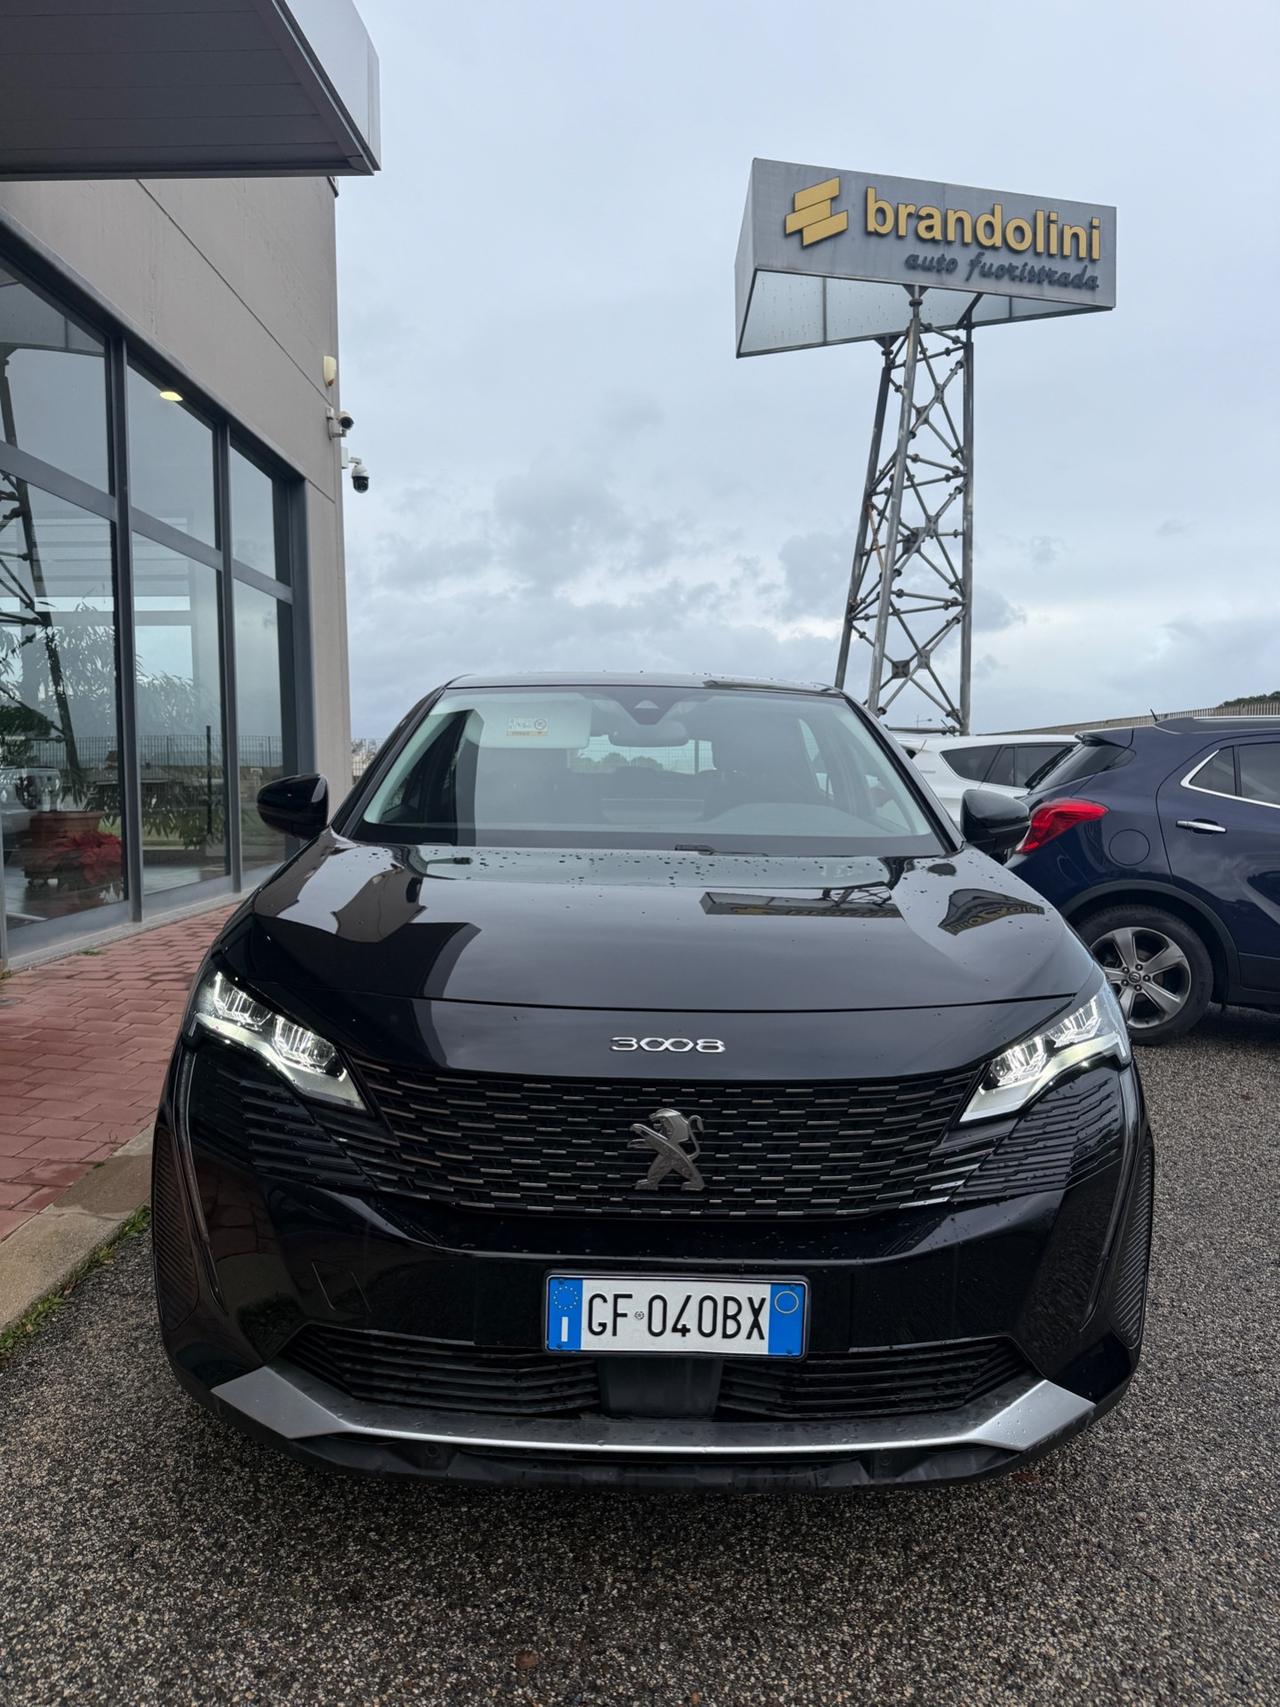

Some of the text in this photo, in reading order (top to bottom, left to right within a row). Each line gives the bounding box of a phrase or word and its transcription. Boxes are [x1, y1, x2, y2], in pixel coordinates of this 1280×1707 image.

[866, 186, 1101, 260] brandolini
[904, 251, 1100, 290] auto fuoristrada
[611, 1036, 726, 1053] 3008
